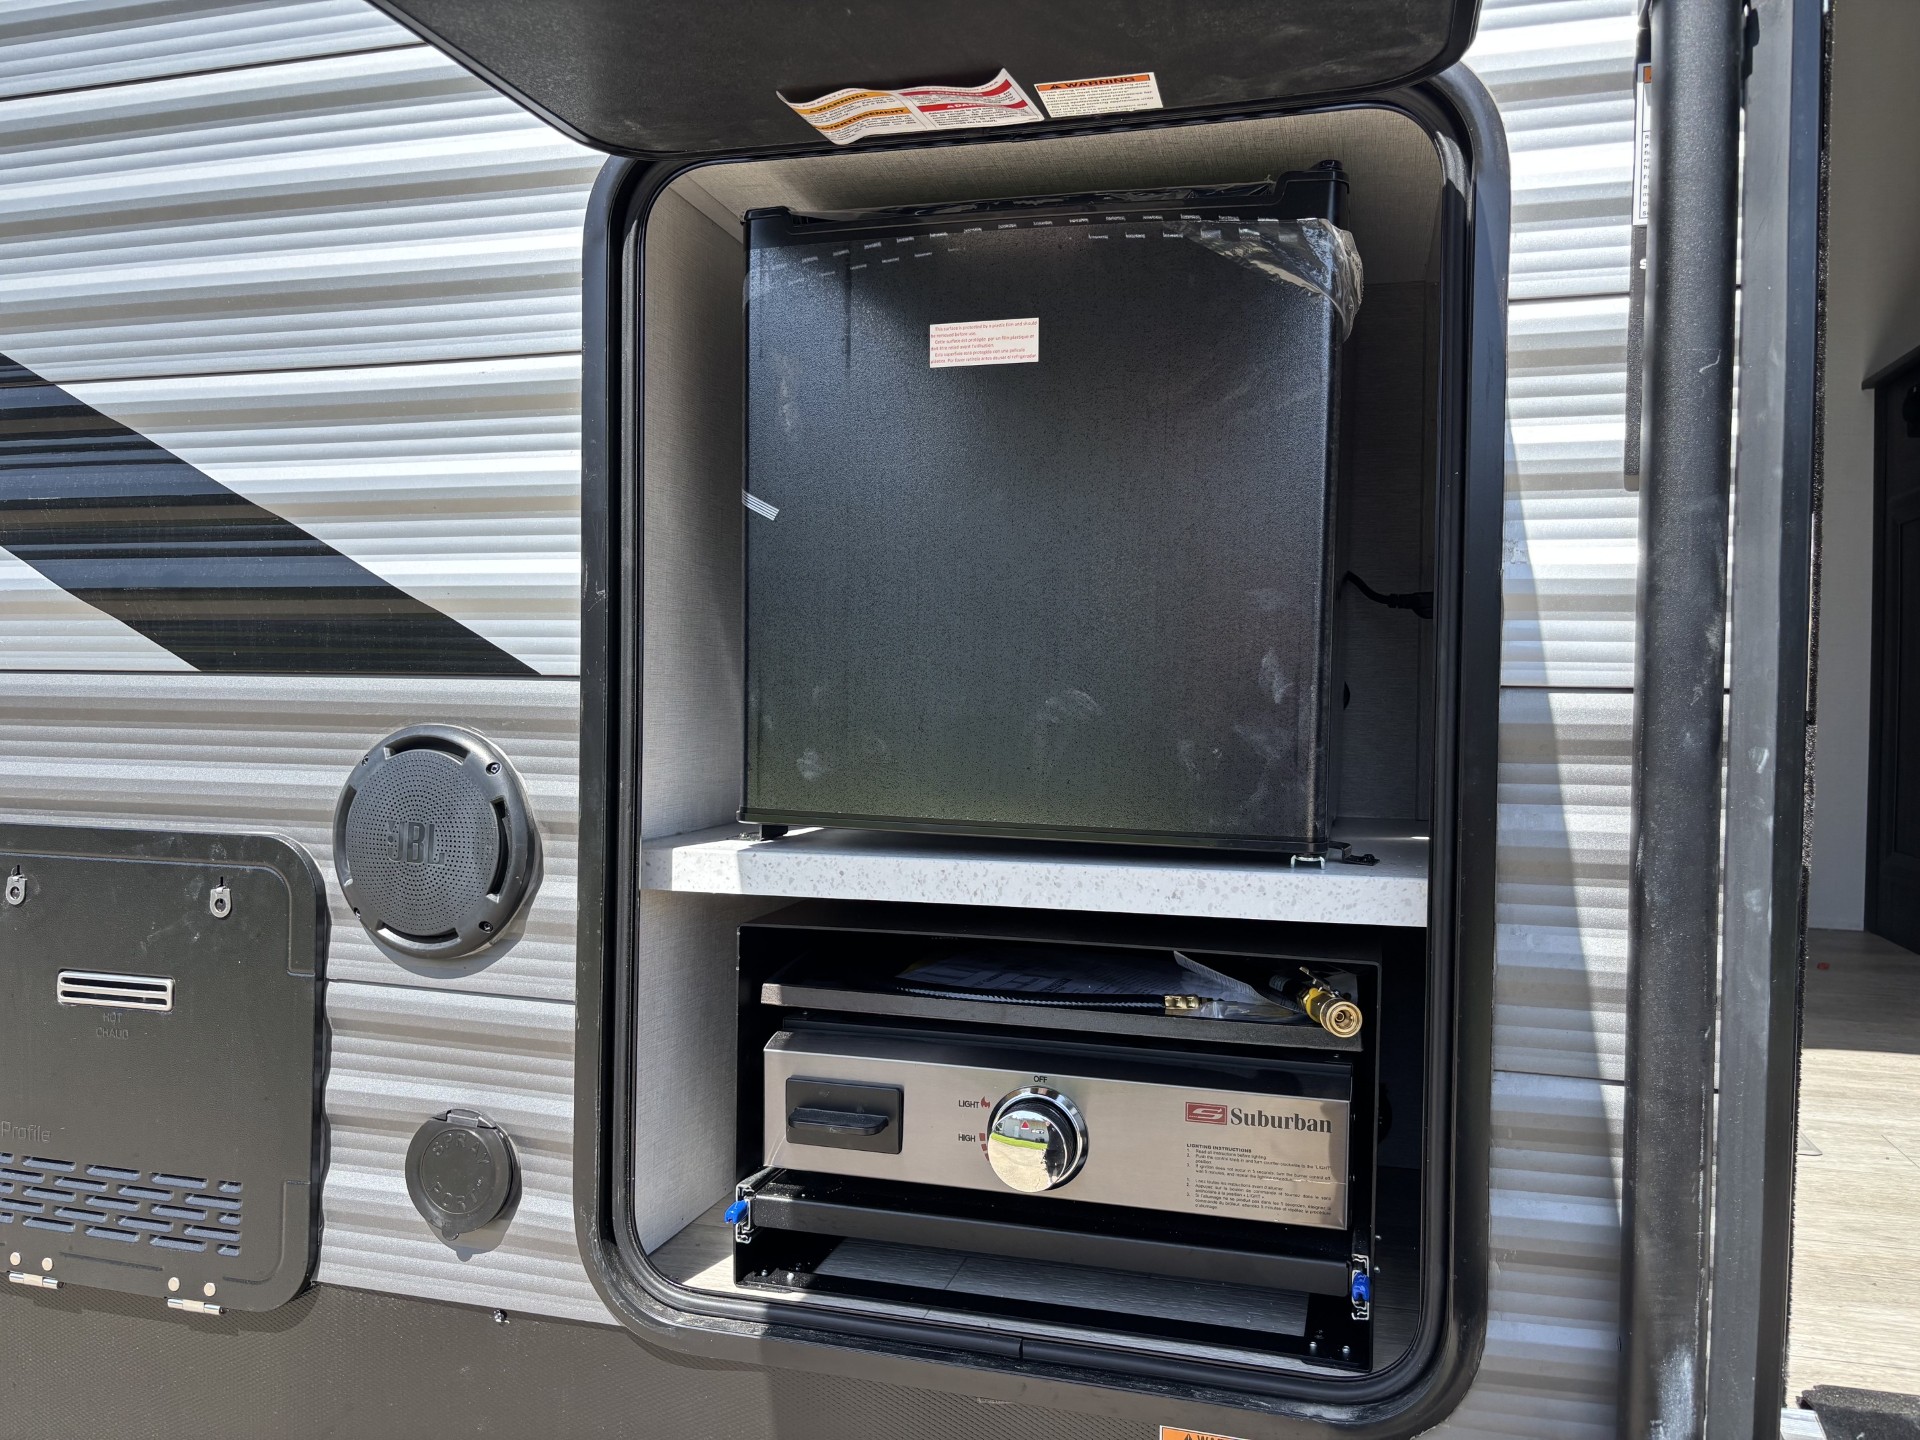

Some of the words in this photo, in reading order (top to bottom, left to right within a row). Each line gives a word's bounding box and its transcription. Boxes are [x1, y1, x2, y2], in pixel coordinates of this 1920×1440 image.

[1065, 77, 1134, 88] WARNING
[387, 820, 445, 866] JBL
[103, 1012, 122, 1023] HOT
[96, 1027, 128, 1039] CHAUD
[958, 1100, 979, 1108] LIGHT
[1230, 1108, 1332, 1133] Suburban
[2, 1120, 51, 1142] Profile
[958, 1134, 976, 1142] HIGH
